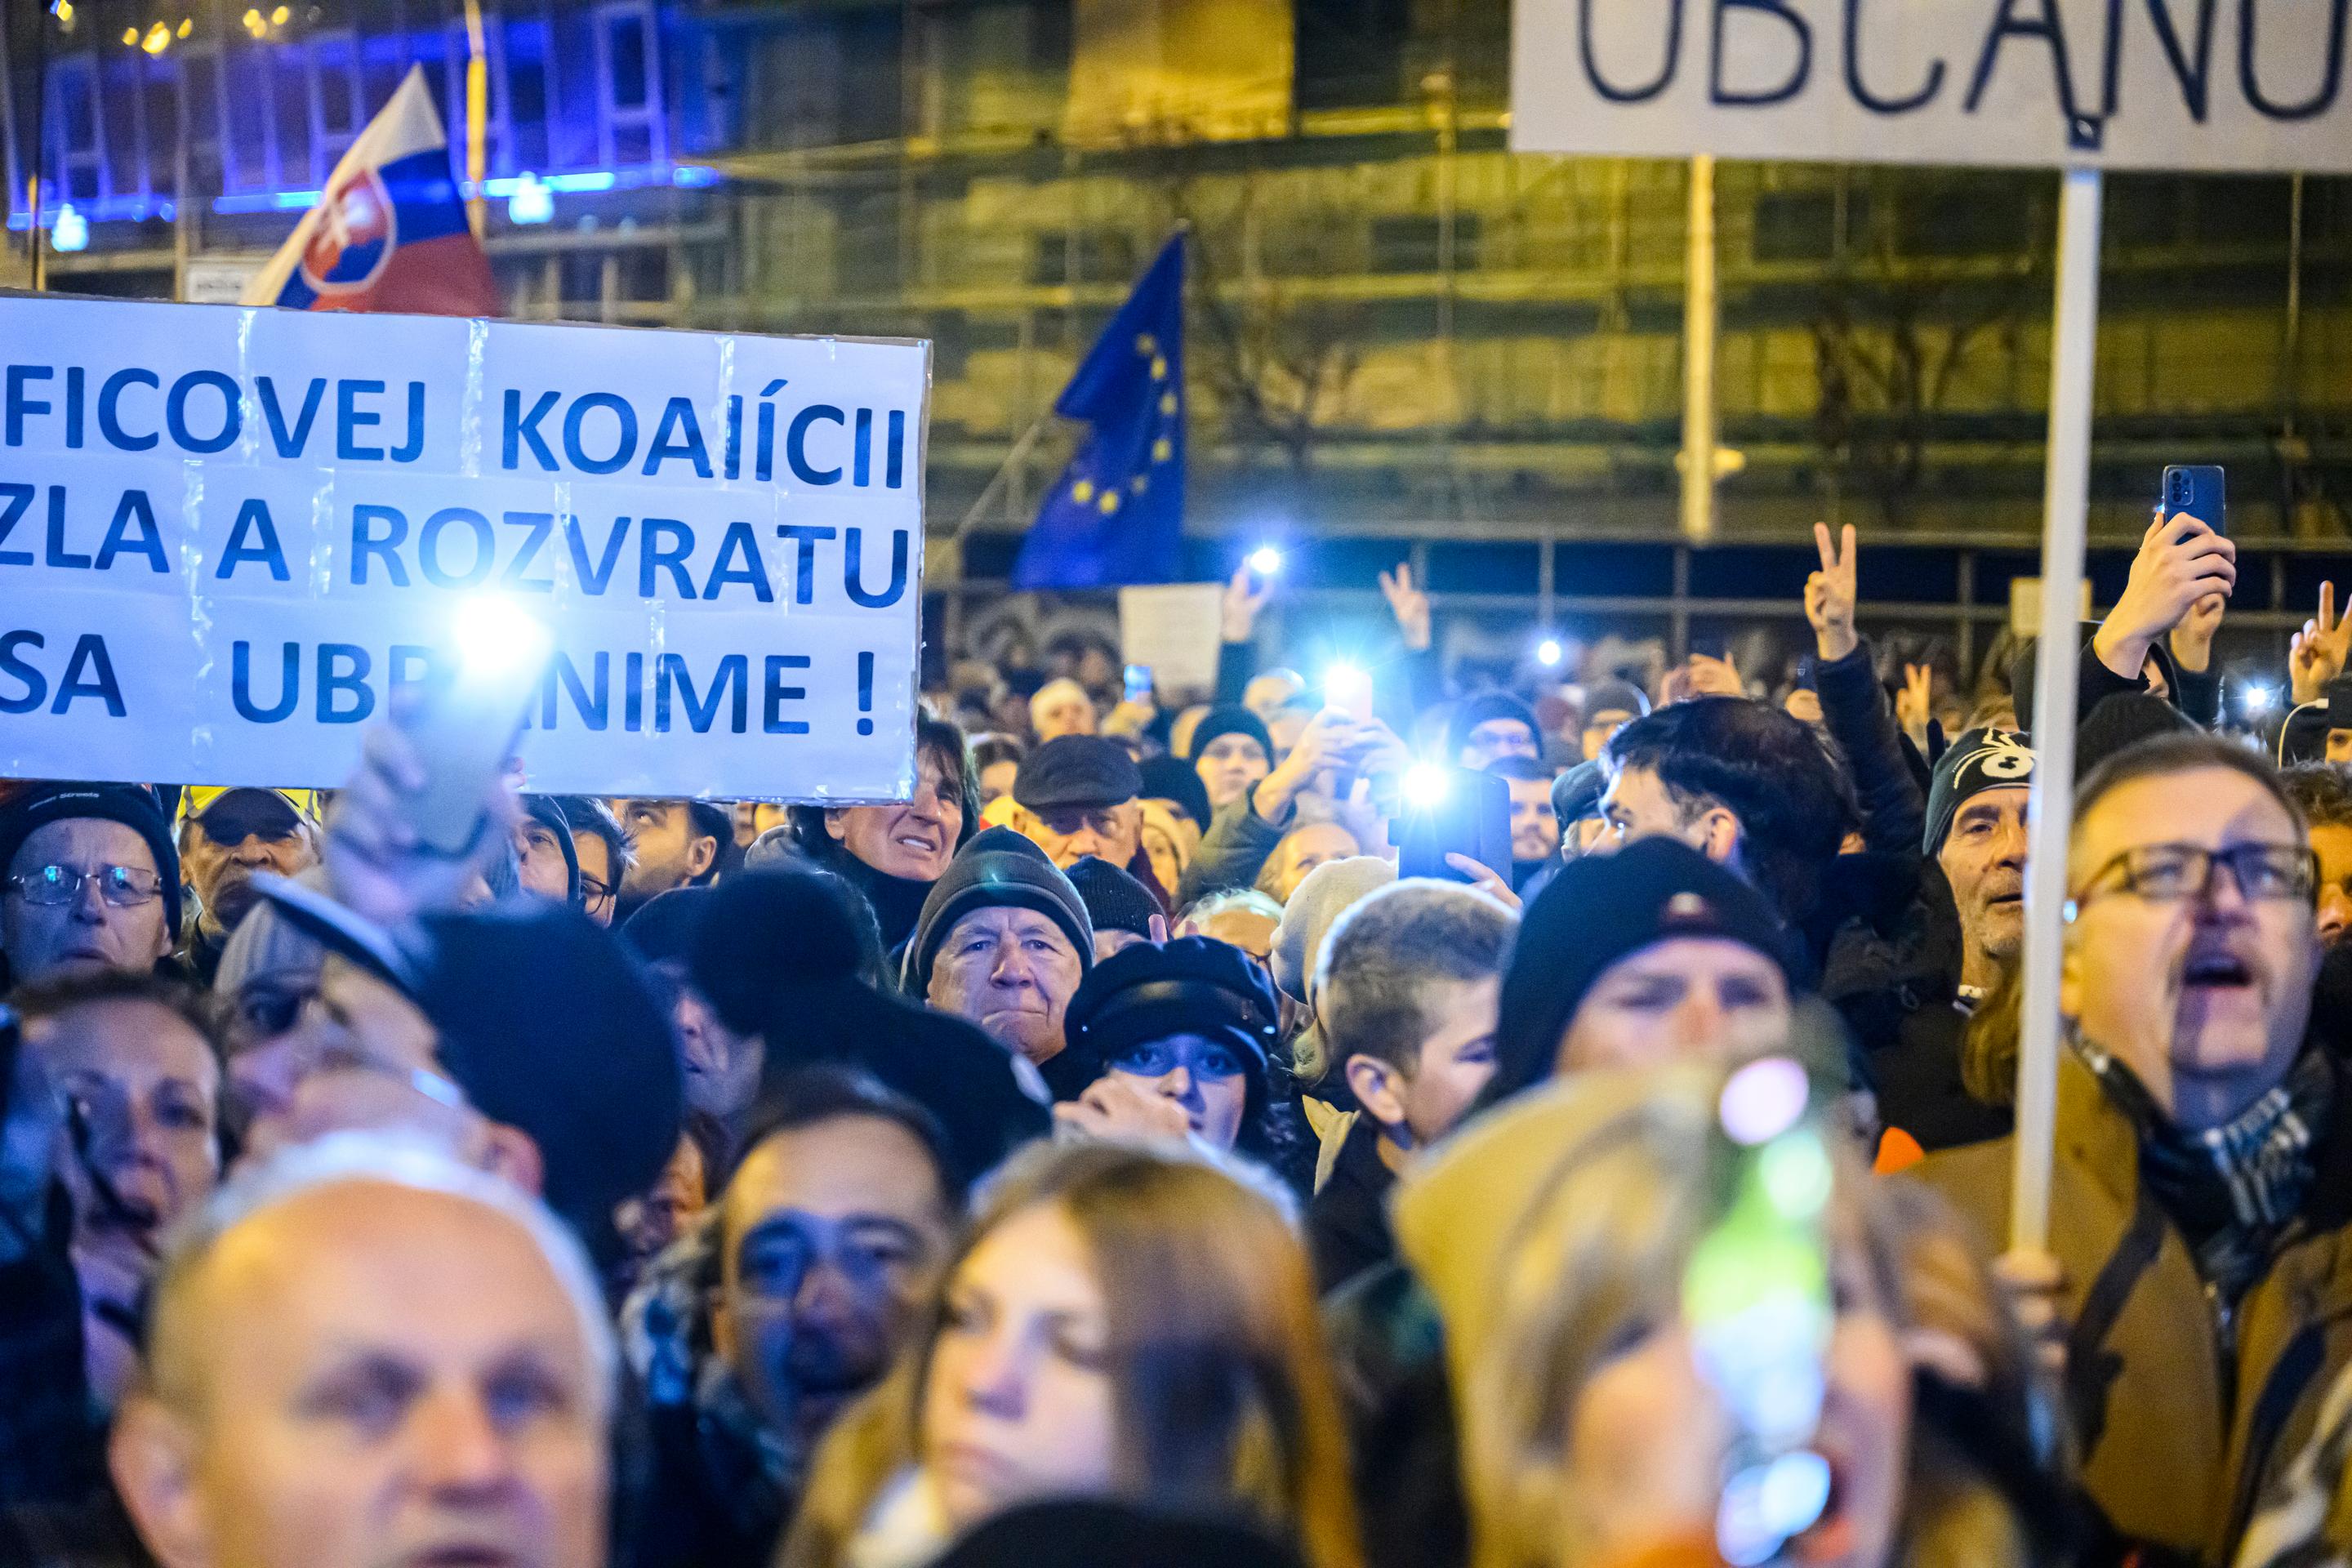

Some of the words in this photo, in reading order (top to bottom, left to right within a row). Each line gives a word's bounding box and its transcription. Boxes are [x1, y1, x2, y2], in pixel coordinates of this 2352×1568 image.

[5, 364, 426, 463] FICOVEJ
[0, 482, 170, 573] ZLA
[215, 498, 292, 581] A
[350, 503, 910, 608] ROZVRATU
[0, 629, 127, 718] SA
[856, 650, 875, 736] !
